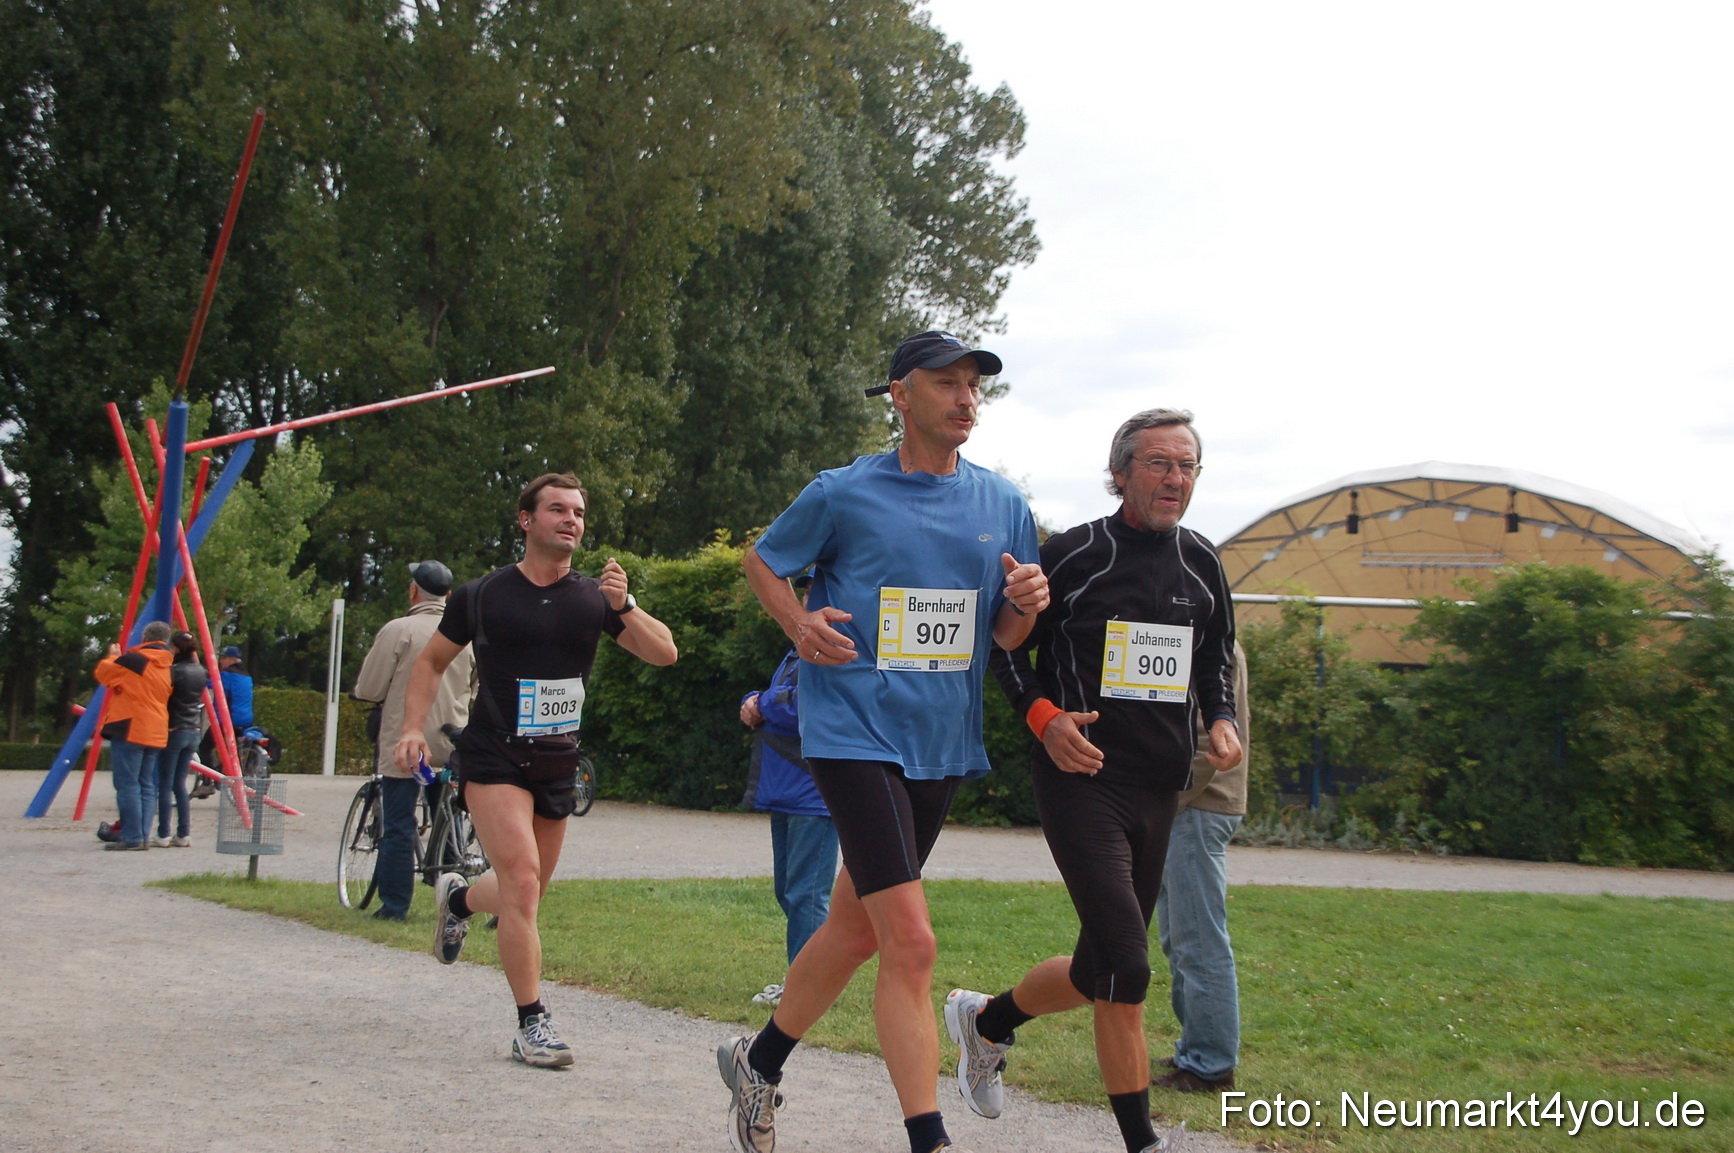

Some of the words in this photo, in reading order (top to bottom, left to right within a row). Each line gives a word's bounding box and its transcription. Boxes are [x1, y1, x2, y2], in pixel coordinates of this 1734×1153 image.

[908, 596, 966, 613] Bernhard
[883, 619, 891, 631] C
[916, 622, 960, 645] 907
[1131, 630, 1182, 648] Johannes
[1138, 654, 1177, 677] 900
[540, 686, 566, 696] Marco
[524, 701, 530, 709] C
[540, 699, 577, 716] 3003
